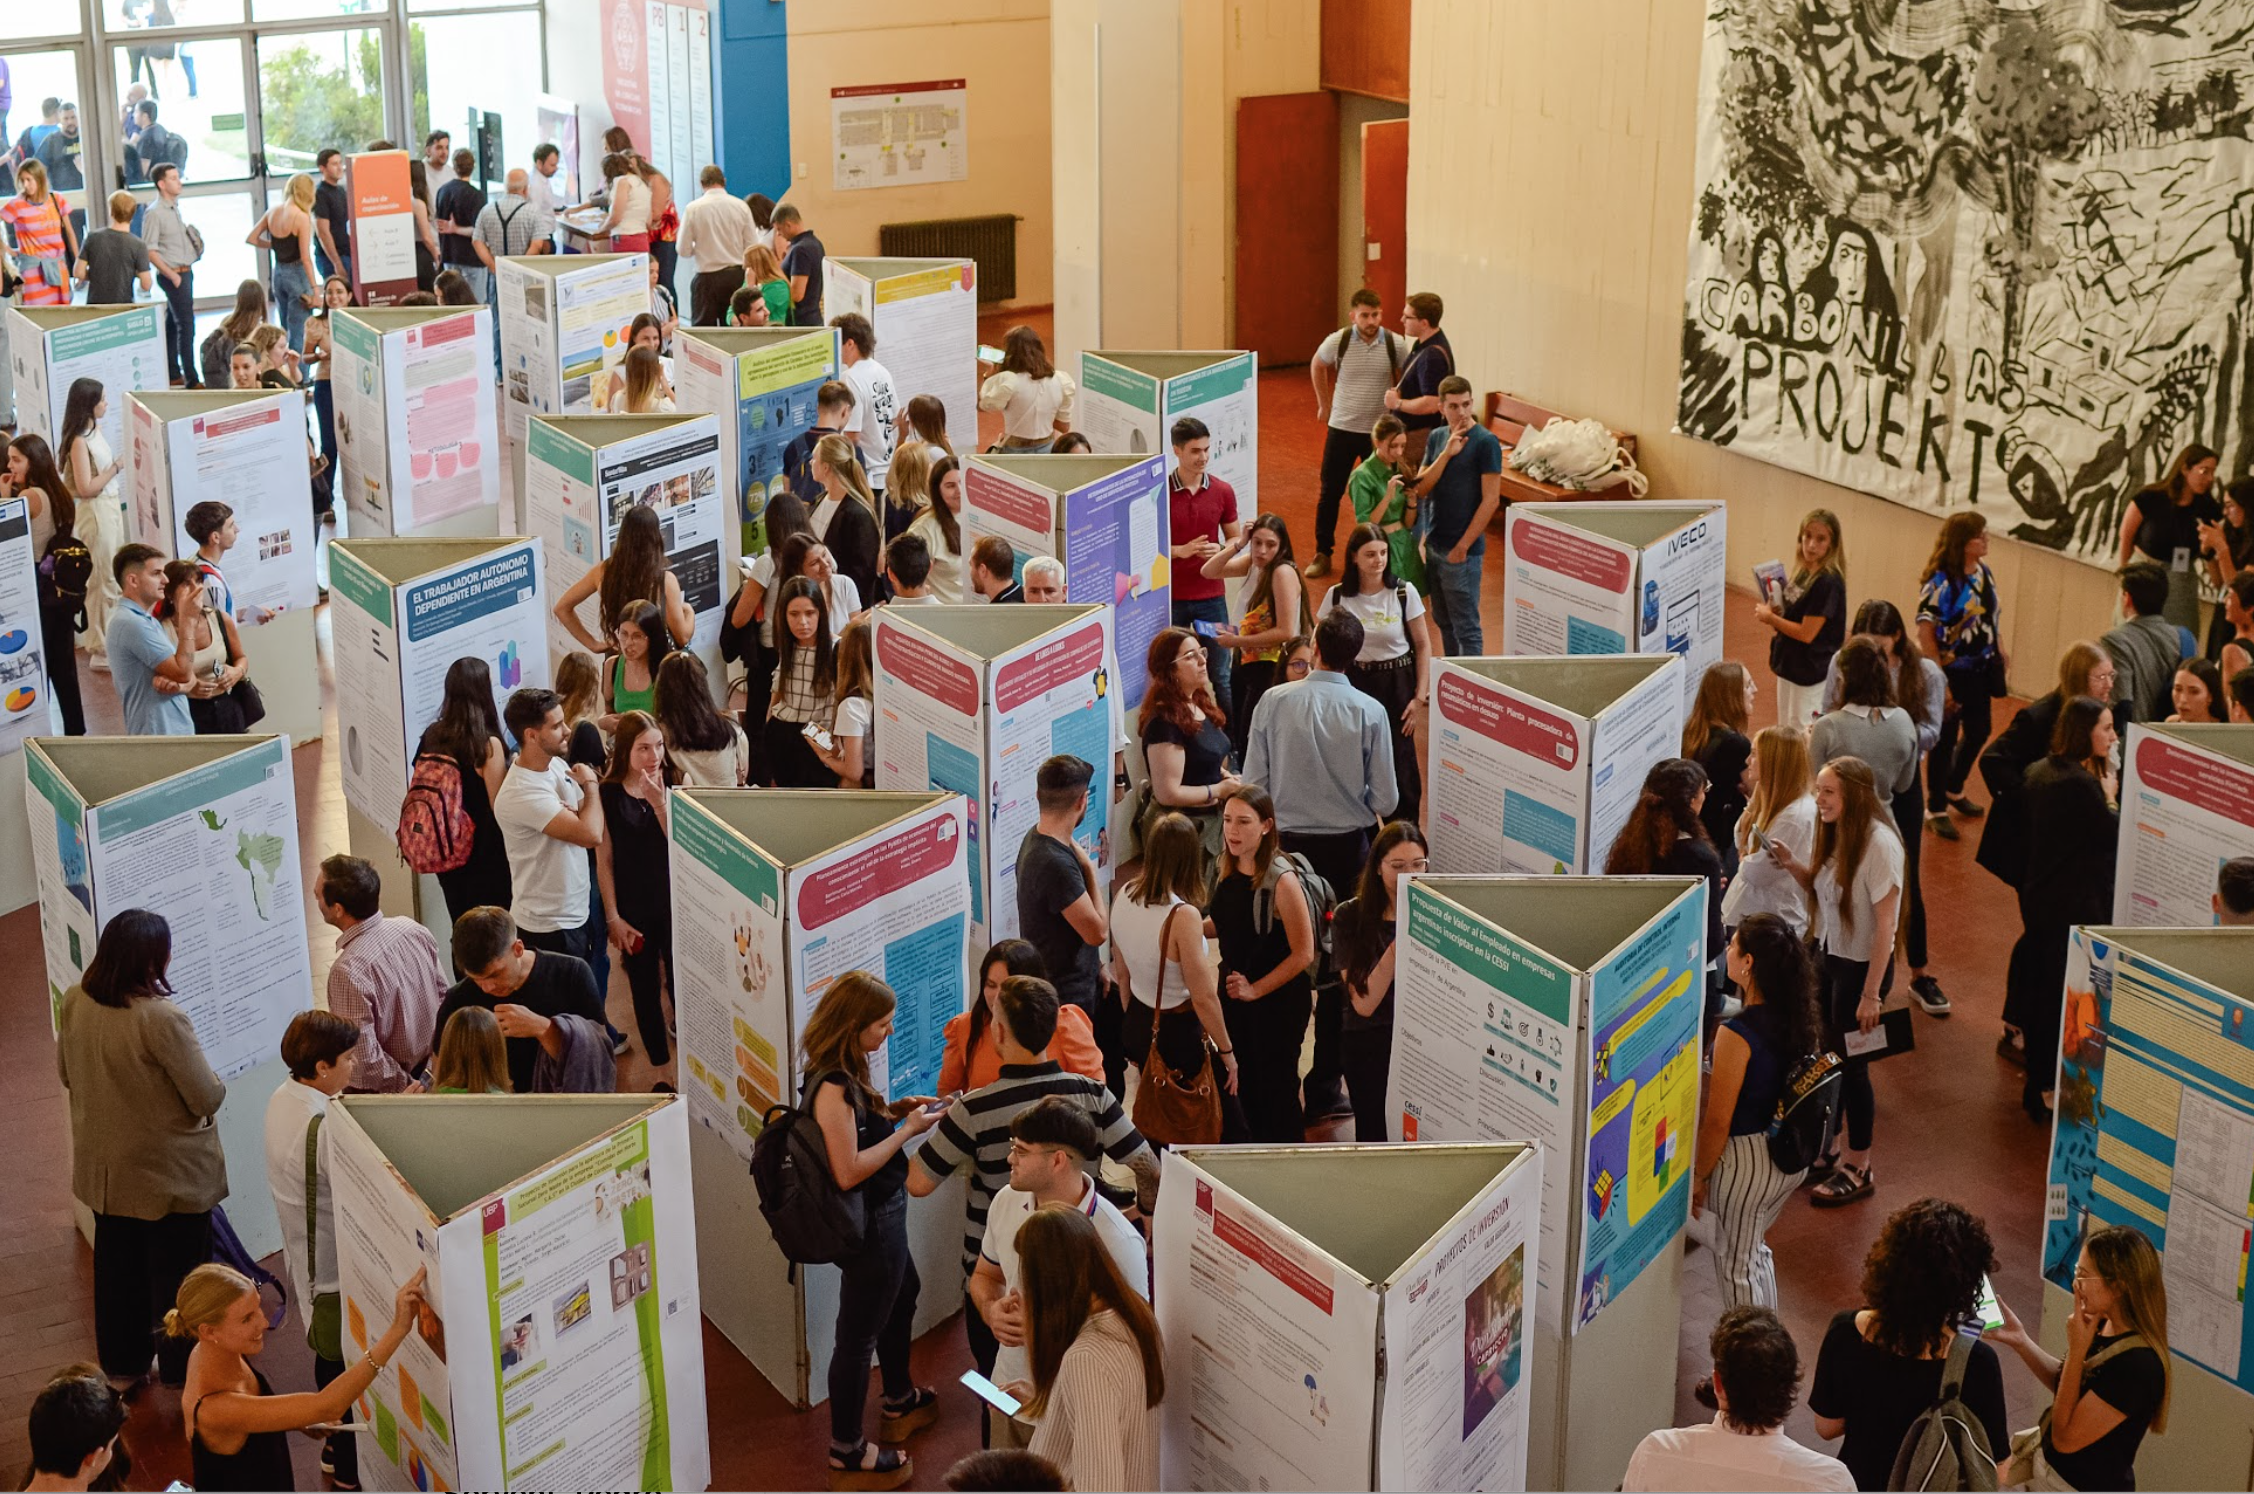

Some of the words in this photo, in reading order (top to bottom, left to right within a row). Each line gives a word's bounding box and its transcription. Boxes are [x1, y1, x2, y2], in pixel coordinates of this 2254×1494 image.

[679, 12, 684, 32] 1
[699, 16, 706, 36] 2
[361, 196, 379, 204] Aulas
[1667, 522, 1707, 557] IVECO
[413, 591, 422, 604] EL
[424, 571, 478, 600] TRABAJADOR
[415, 587, 468, 616] DEPENDIENTE
[470, 582, 481, 596] EN
[482, 565, 527, 592] ARGENTINA
[1441, 690, 1470, 709] neumáticos
[1472, 704, 1478, 712] en
[1480, 706, 1499, 721] desuso
[1441, 678, 1464, 697] Proyecto
[1467, 689, 1473, 700] de
[1506, 705, 1524, 721] Planta
[1528, 715, 1562, 738] procesadora
[1565, 731, 1573, 742] de
[2166, 747, 2209, 769] Determinantes
[2211, 764, 2218, 772] de
[2219, 767, 2225, 775] la
[2198, 771, 2224, 786] servicios
[852, 850, 873, 866] estratégico
[873, 848, 878, 856] en
[902, 834, 907, 843] de
[909, 825, 929, 839] economía
[872, 858, 878, 866] de
[884, 845, 907, 861] estrategia
[907, 835, 926, 850] implícita
[1412, 892, 1442, 919] Propuesta
[1444, 910, 1452, 923] de
[1453, 915, 1470, 934] Valor
[1472, 925, 1478, 938] al
[1479, 930, 1510, 958] Empleado
[1512, 951, 1520, 962] en
[1522, 957, 1555, 984] empresas
[1412, 908, 1442, 935] argentinas
[1443, 926, 1473, 953] inscriptas
[1475, 946, 1483, 957] en
[1484, 949, 1490, 961] la
[1492, 953, 1509, 972] CESSI
[1644, 926, 1661, 947] CONTROL
[1663, 910, 1680, 931] INTERNO
[1410, 939, 1427, 959] Impacto
[1429, 951, 1434, 961] de
[1435, 955, 1440, 965] la
[1440, 958, 1450, 971] PVE
[1451, 967, 1457, 975] en
[1409, 957, 1430, 977] empresas
[1431, 969, 1436, 979] IT
[1437, 973, 1443, 984] de
[1444, 978, 1466, 999] Argentina
[1401, 1026, 1421, 1047] Objetivos
[1479, 1066, 1506, 1089] Discusión
[1404, 1097, 1422, 1118] cessi
[1477, 1117, 1506, 1144] Principales
[518, 1194, 536, 1210] Sucursal
[538, 1188, 548, 1199] Zero
[549, 1180, 561, 1192] Waste
[563, 1177, 567, 1185] de
[569, 1174, 573, 1182] la
[575, 1164, 593, 1180] empresa
[595, 1150, 615, 1168] "Comidas
[624, 1139, 636, 1151] Norte
[520, 1184, 540, 1201] Proyecto
[541, 1180, 547, 1188] de
[548, 1169, 567, 1185] inversión
[568, 1163, 579, 1175] para
[579, 1160, 584, 1168] la
[585, 1149, 604, 1166] apertura
[605, 1146, 610, 1154] de
[611, 1142, 616, 1150] la
[618, 1133, 633, 1147] Primera
[565, 1184, 569, 1192] la
[571, 1175, 586, 1189] Ciudad
[587, 1171, 593, 1180] de
[610, 1185, 637, 1207] WASTE
[612, 1175, 633, 1195] ZERO
[483, 1202, 498, 1218] UBP
[1435, 1232, 1466, 1278] PROYECTOS
[1468, 1224, 1476, 1245] DE
[1477, 1192, 1509, 1238] INVERSIÓN
[1477, 1325, 1508, 1368] CAPRICCIO
